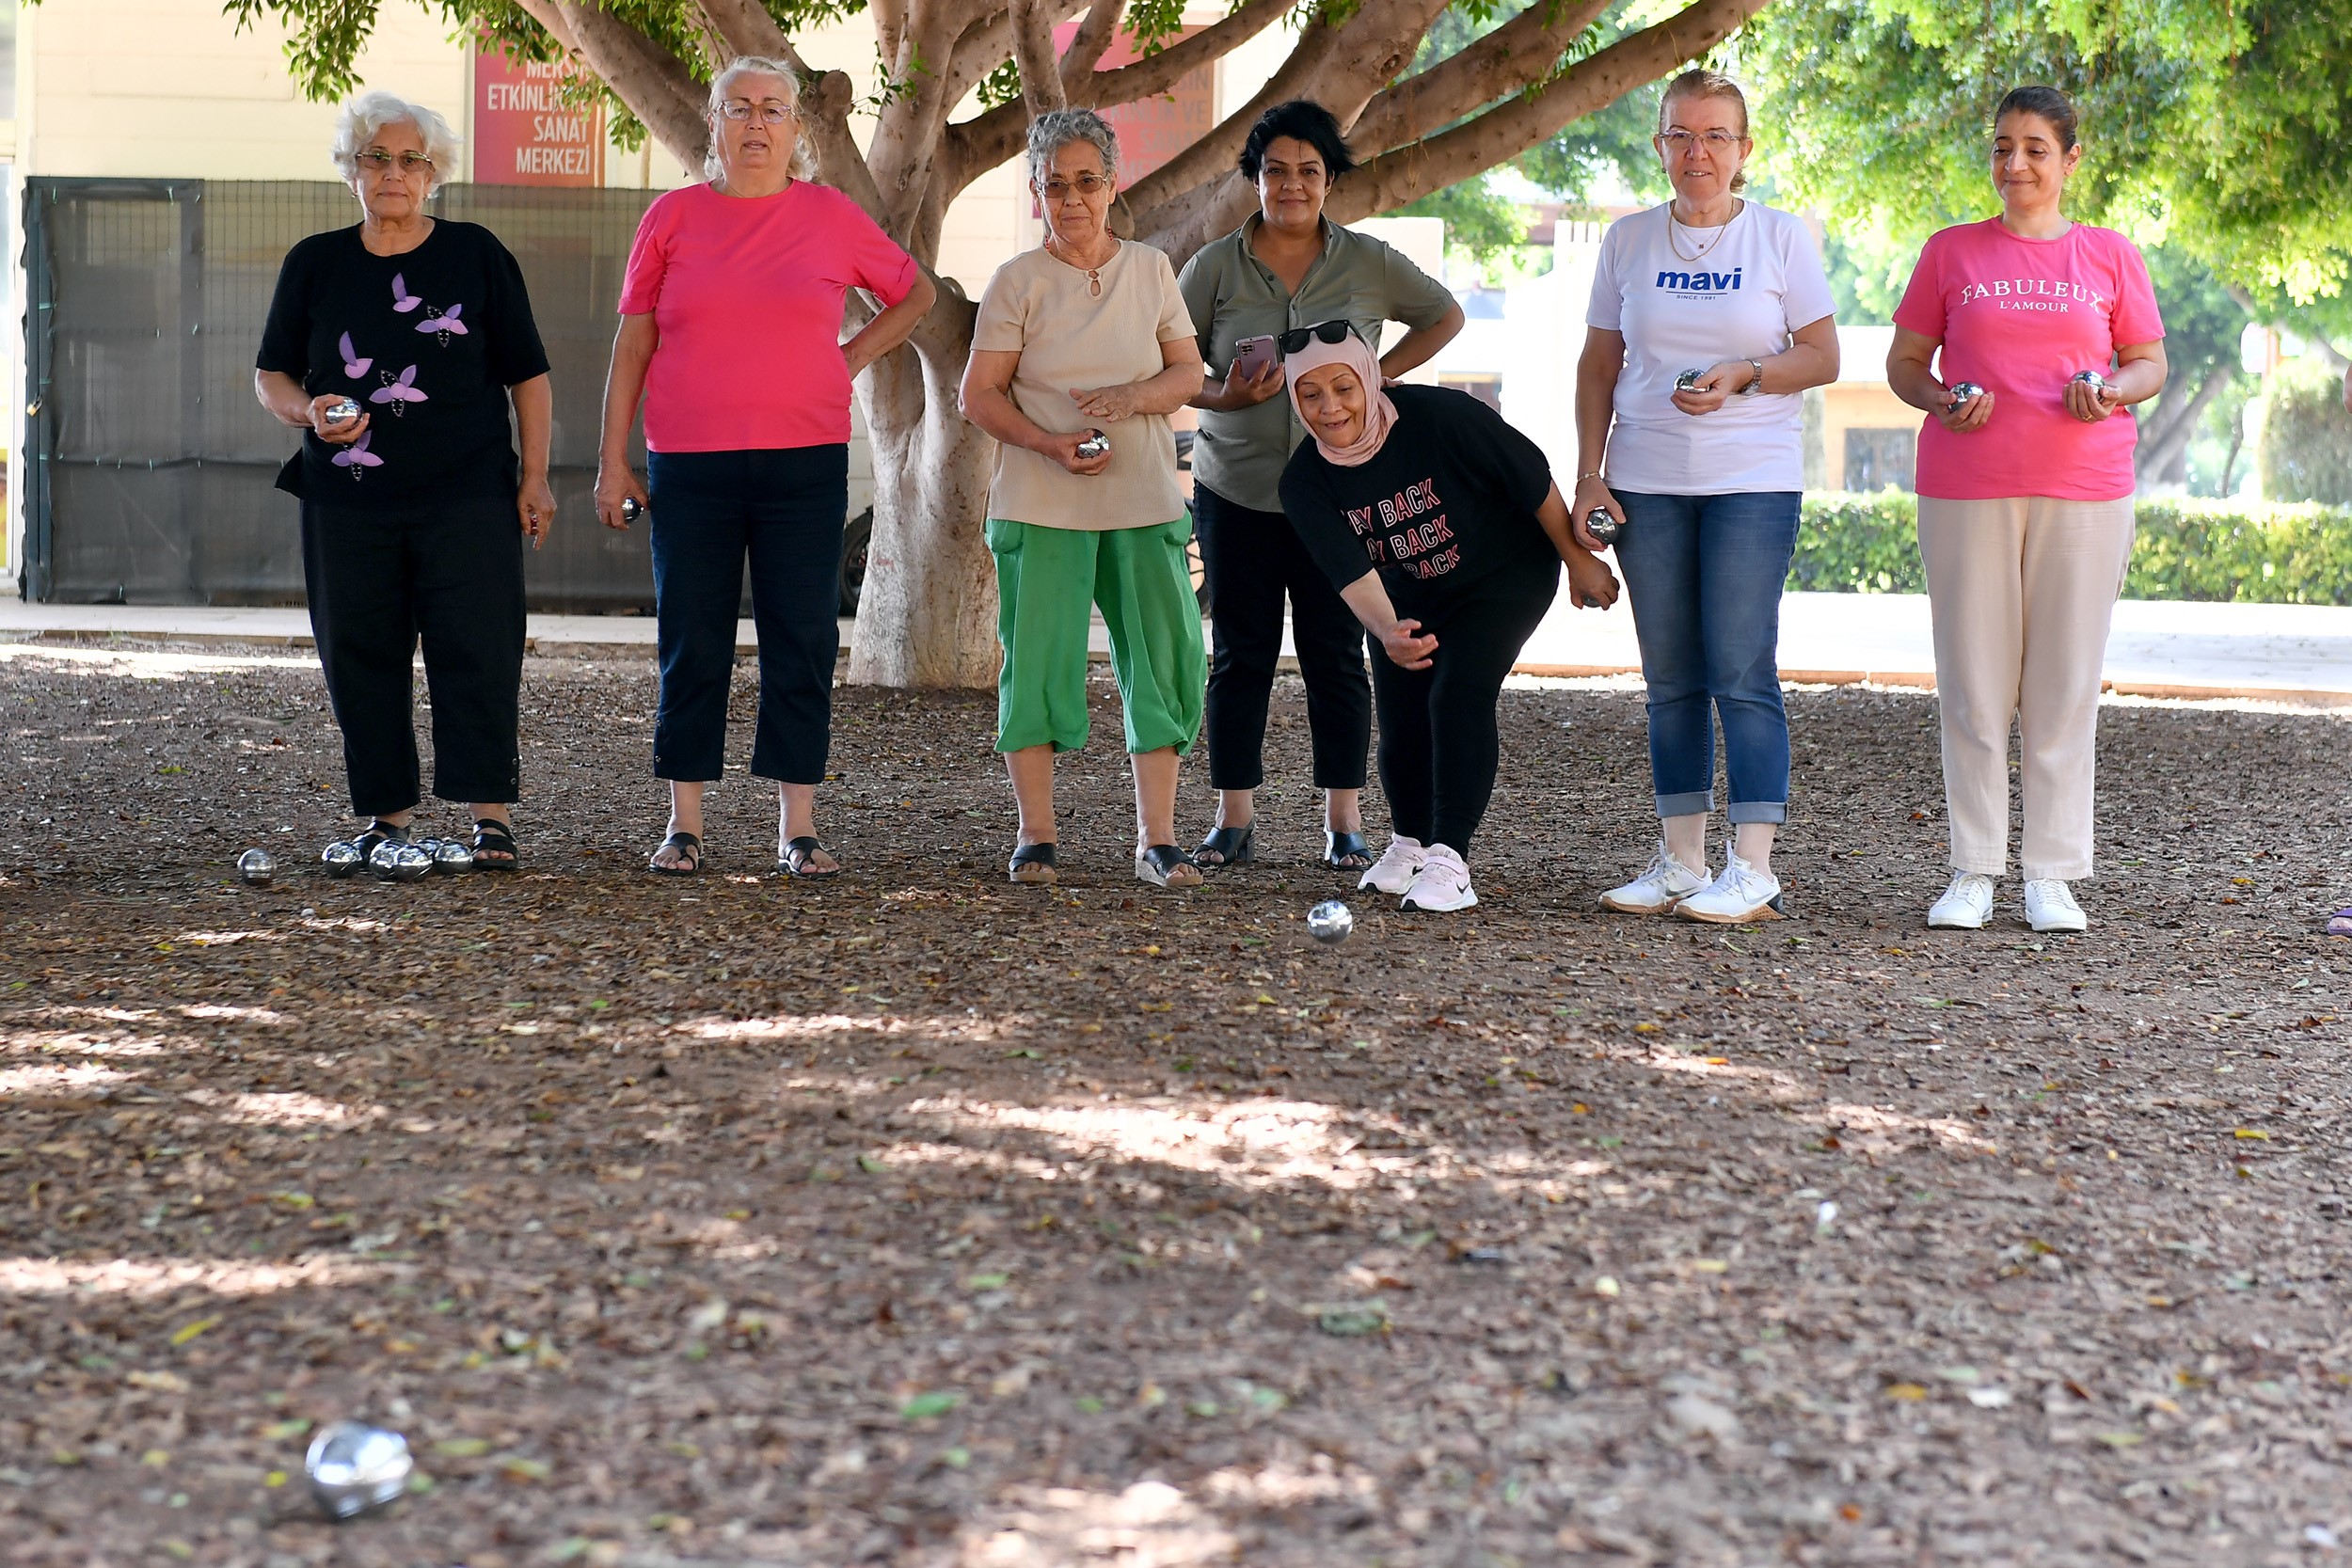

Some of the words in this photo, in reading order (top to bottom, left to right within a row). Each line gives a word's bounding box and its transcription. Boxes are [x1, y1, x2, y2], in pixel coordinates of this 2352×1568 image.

[1182, 100, 1207, 124] VE
[533, 116, 590, 143] SANAT
[516, 144, 590, 176] MERKEZİ
[1656, 267, 1742, 291] mavi
[1961, 278, 2105, 315] FABULEUX
[1999, 300, 2070, 313] L'AMOUR
[1377, 478, 1441, 529] BACK
[1390, 514, 1454, 560] BACK
